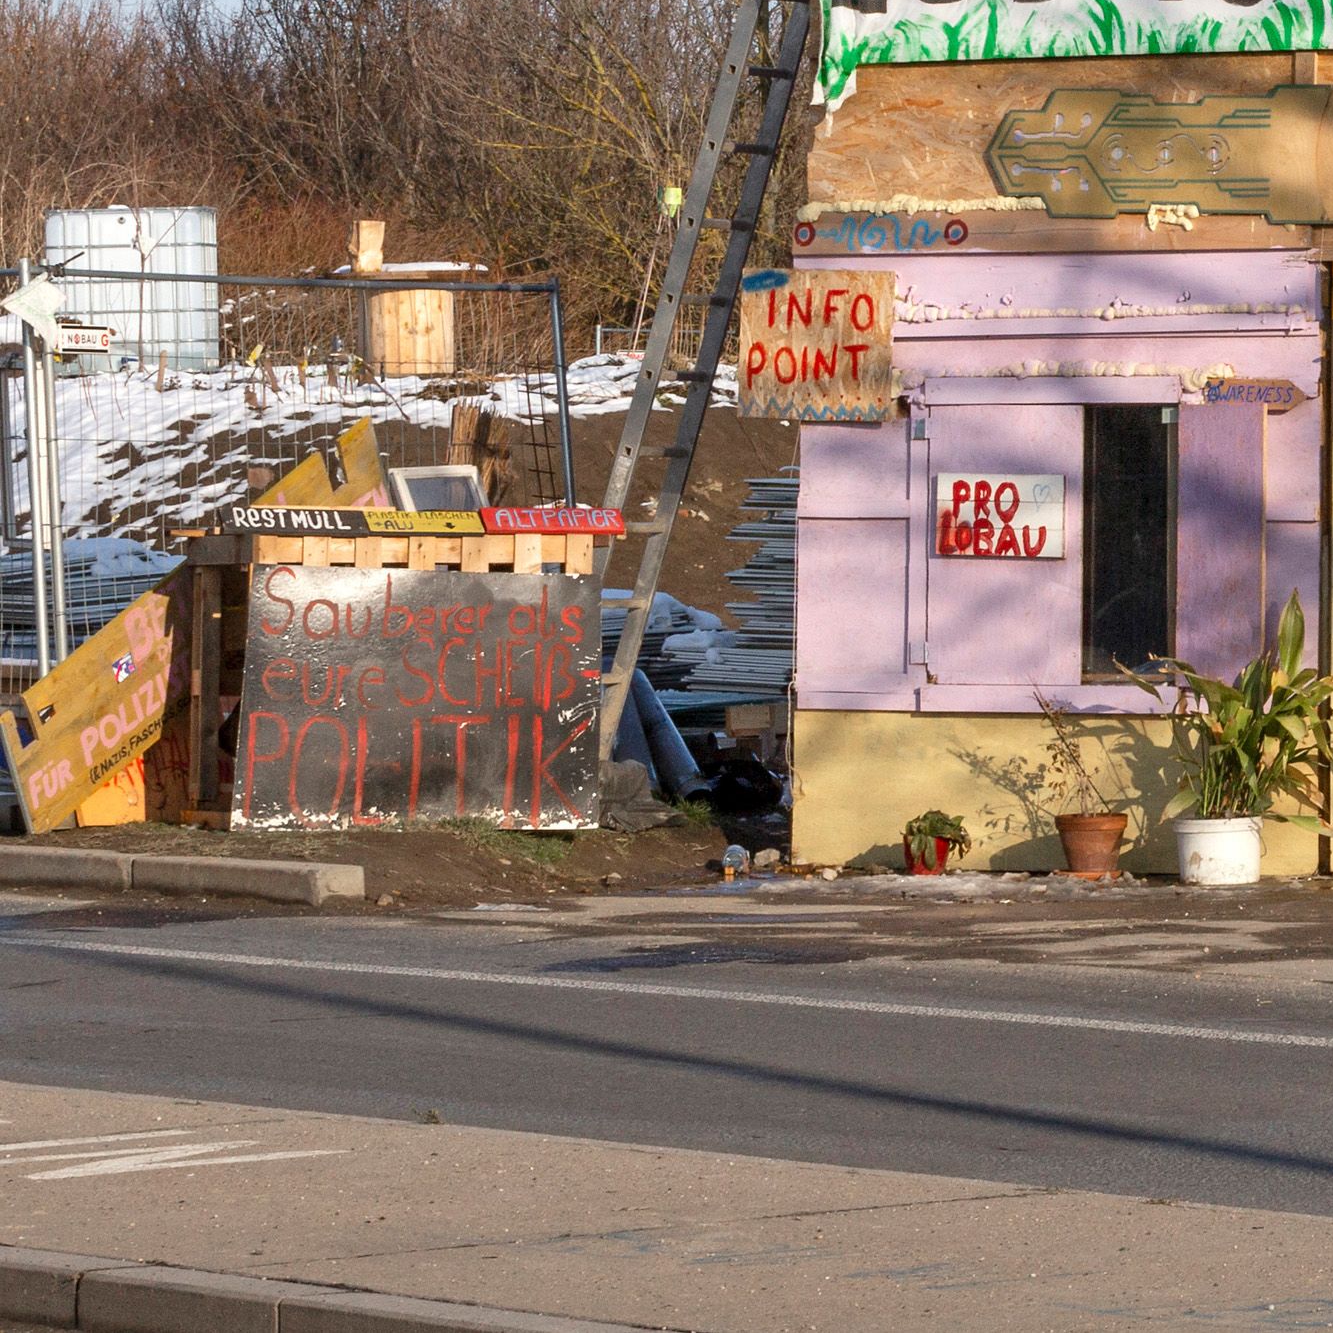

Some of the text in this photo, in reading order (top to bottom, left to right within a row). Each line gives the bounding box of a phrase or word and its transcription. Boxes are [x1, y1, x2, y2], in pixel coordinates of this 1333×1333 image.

[767, 288, 875, 333] INFO
[746, 341, 871, 391] POINT
[952, 479, 1021, 524] PRO
[939, 509, 1047, 558] LOBAU
[261, 566, 585, 644] Sauberer als
[261, 658, 386, 711] eure
[27, 757, 74, 810] FÜR
[243, 711, 592, 830] POLITIK
